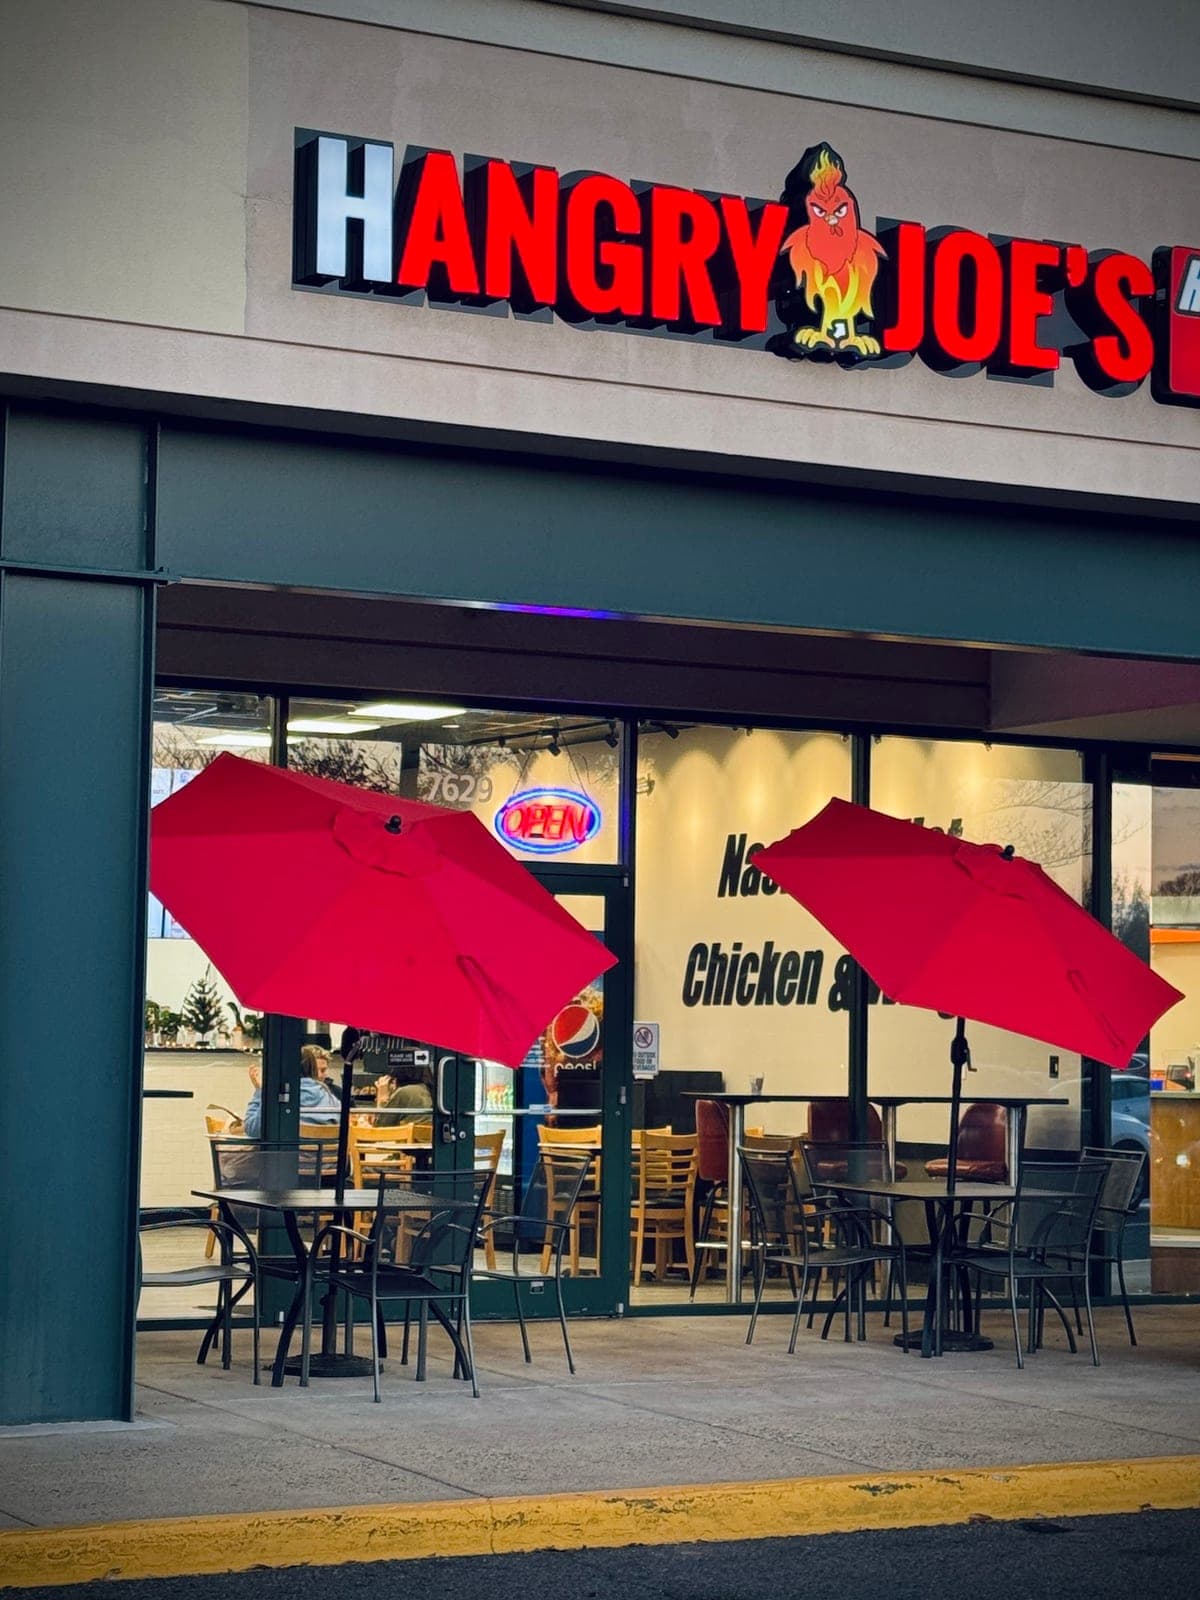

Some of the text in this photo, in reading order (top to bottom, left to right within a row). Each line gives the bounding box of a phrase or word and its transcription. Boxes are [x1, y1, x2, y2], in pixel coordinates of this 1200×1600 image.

[314, 135, 1154, 384] HANGRY JOE'S
[427, 771, 494, 804] 7629
[502, 804, 591, 843] OPEN
[682, 940, 824, 1008] Chicken
